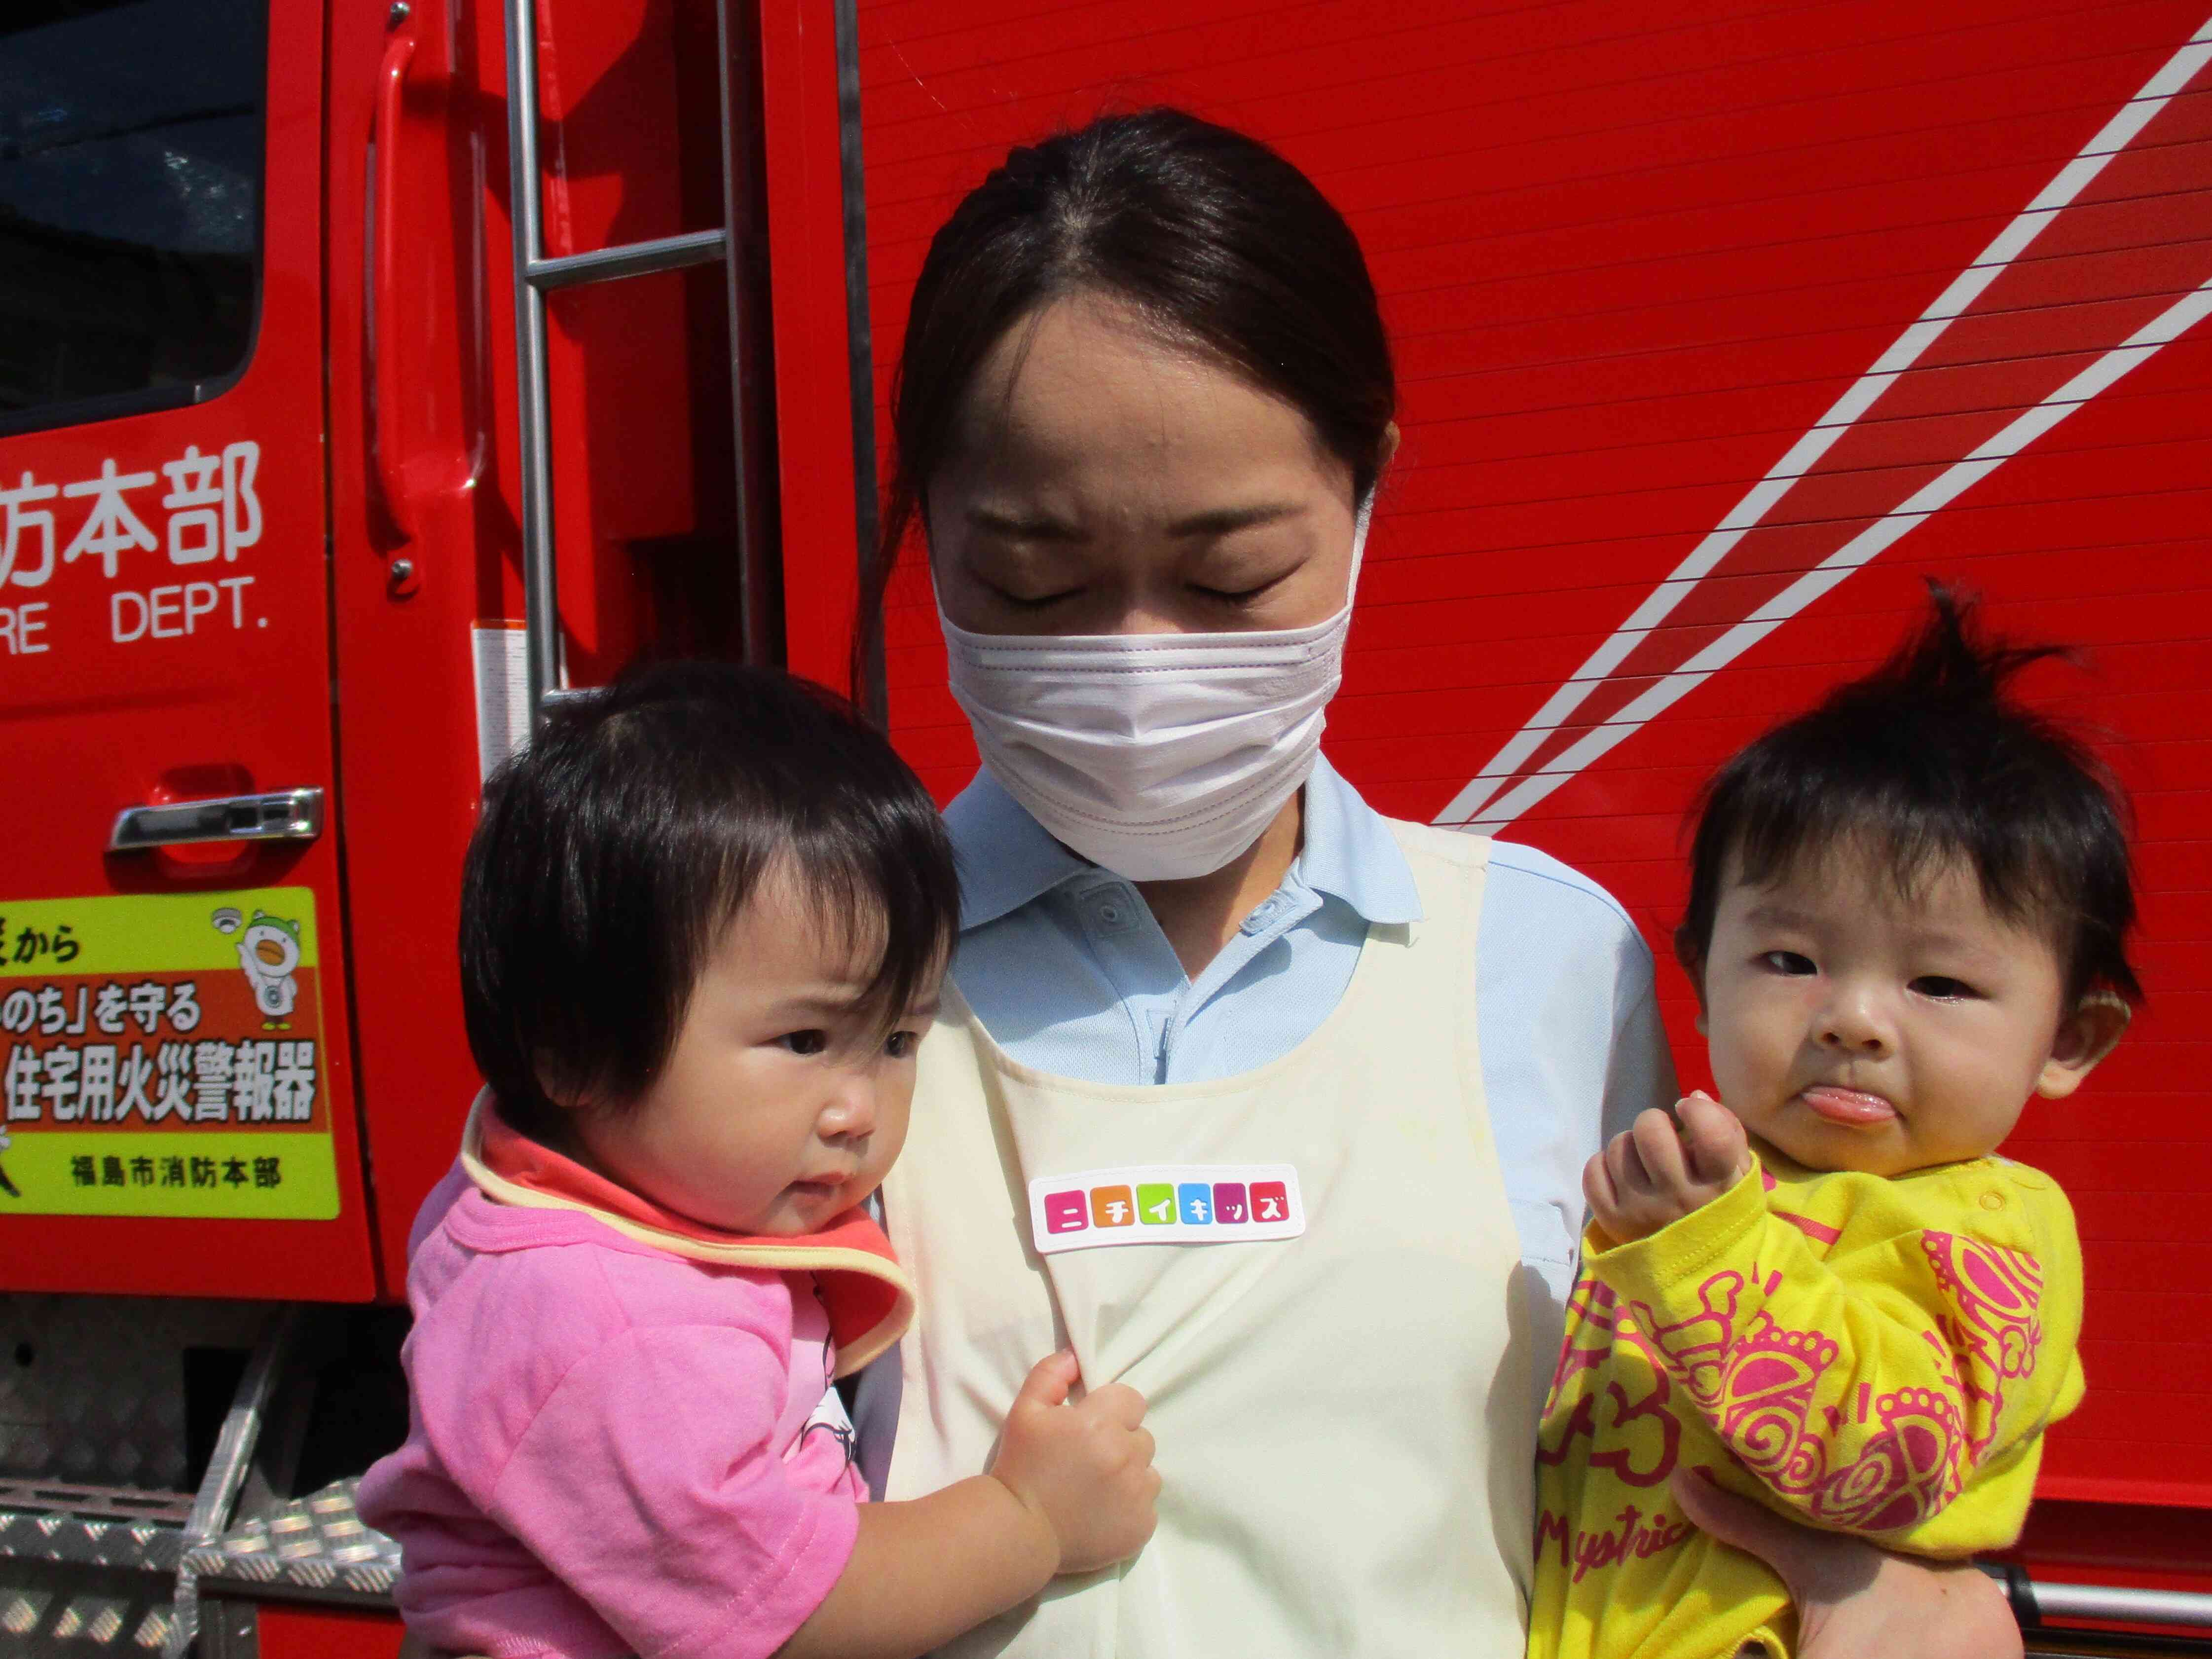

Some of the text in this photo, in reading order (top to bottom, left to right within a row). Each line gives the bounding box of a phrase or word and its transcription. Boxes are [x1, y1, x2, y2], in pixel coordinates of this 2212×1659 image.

[111, 576, 268, 643] DEPT.
[0, 917, 79, 965] から
[2, 981, 200, 1034] のち」を守る
[5, 1040, 316, 1121] 住宅用火災警報器
[71, 1155, 282, 1188] 福島市消防本部
[1059, 1193, 1286, 1229] ニチイキッズ
